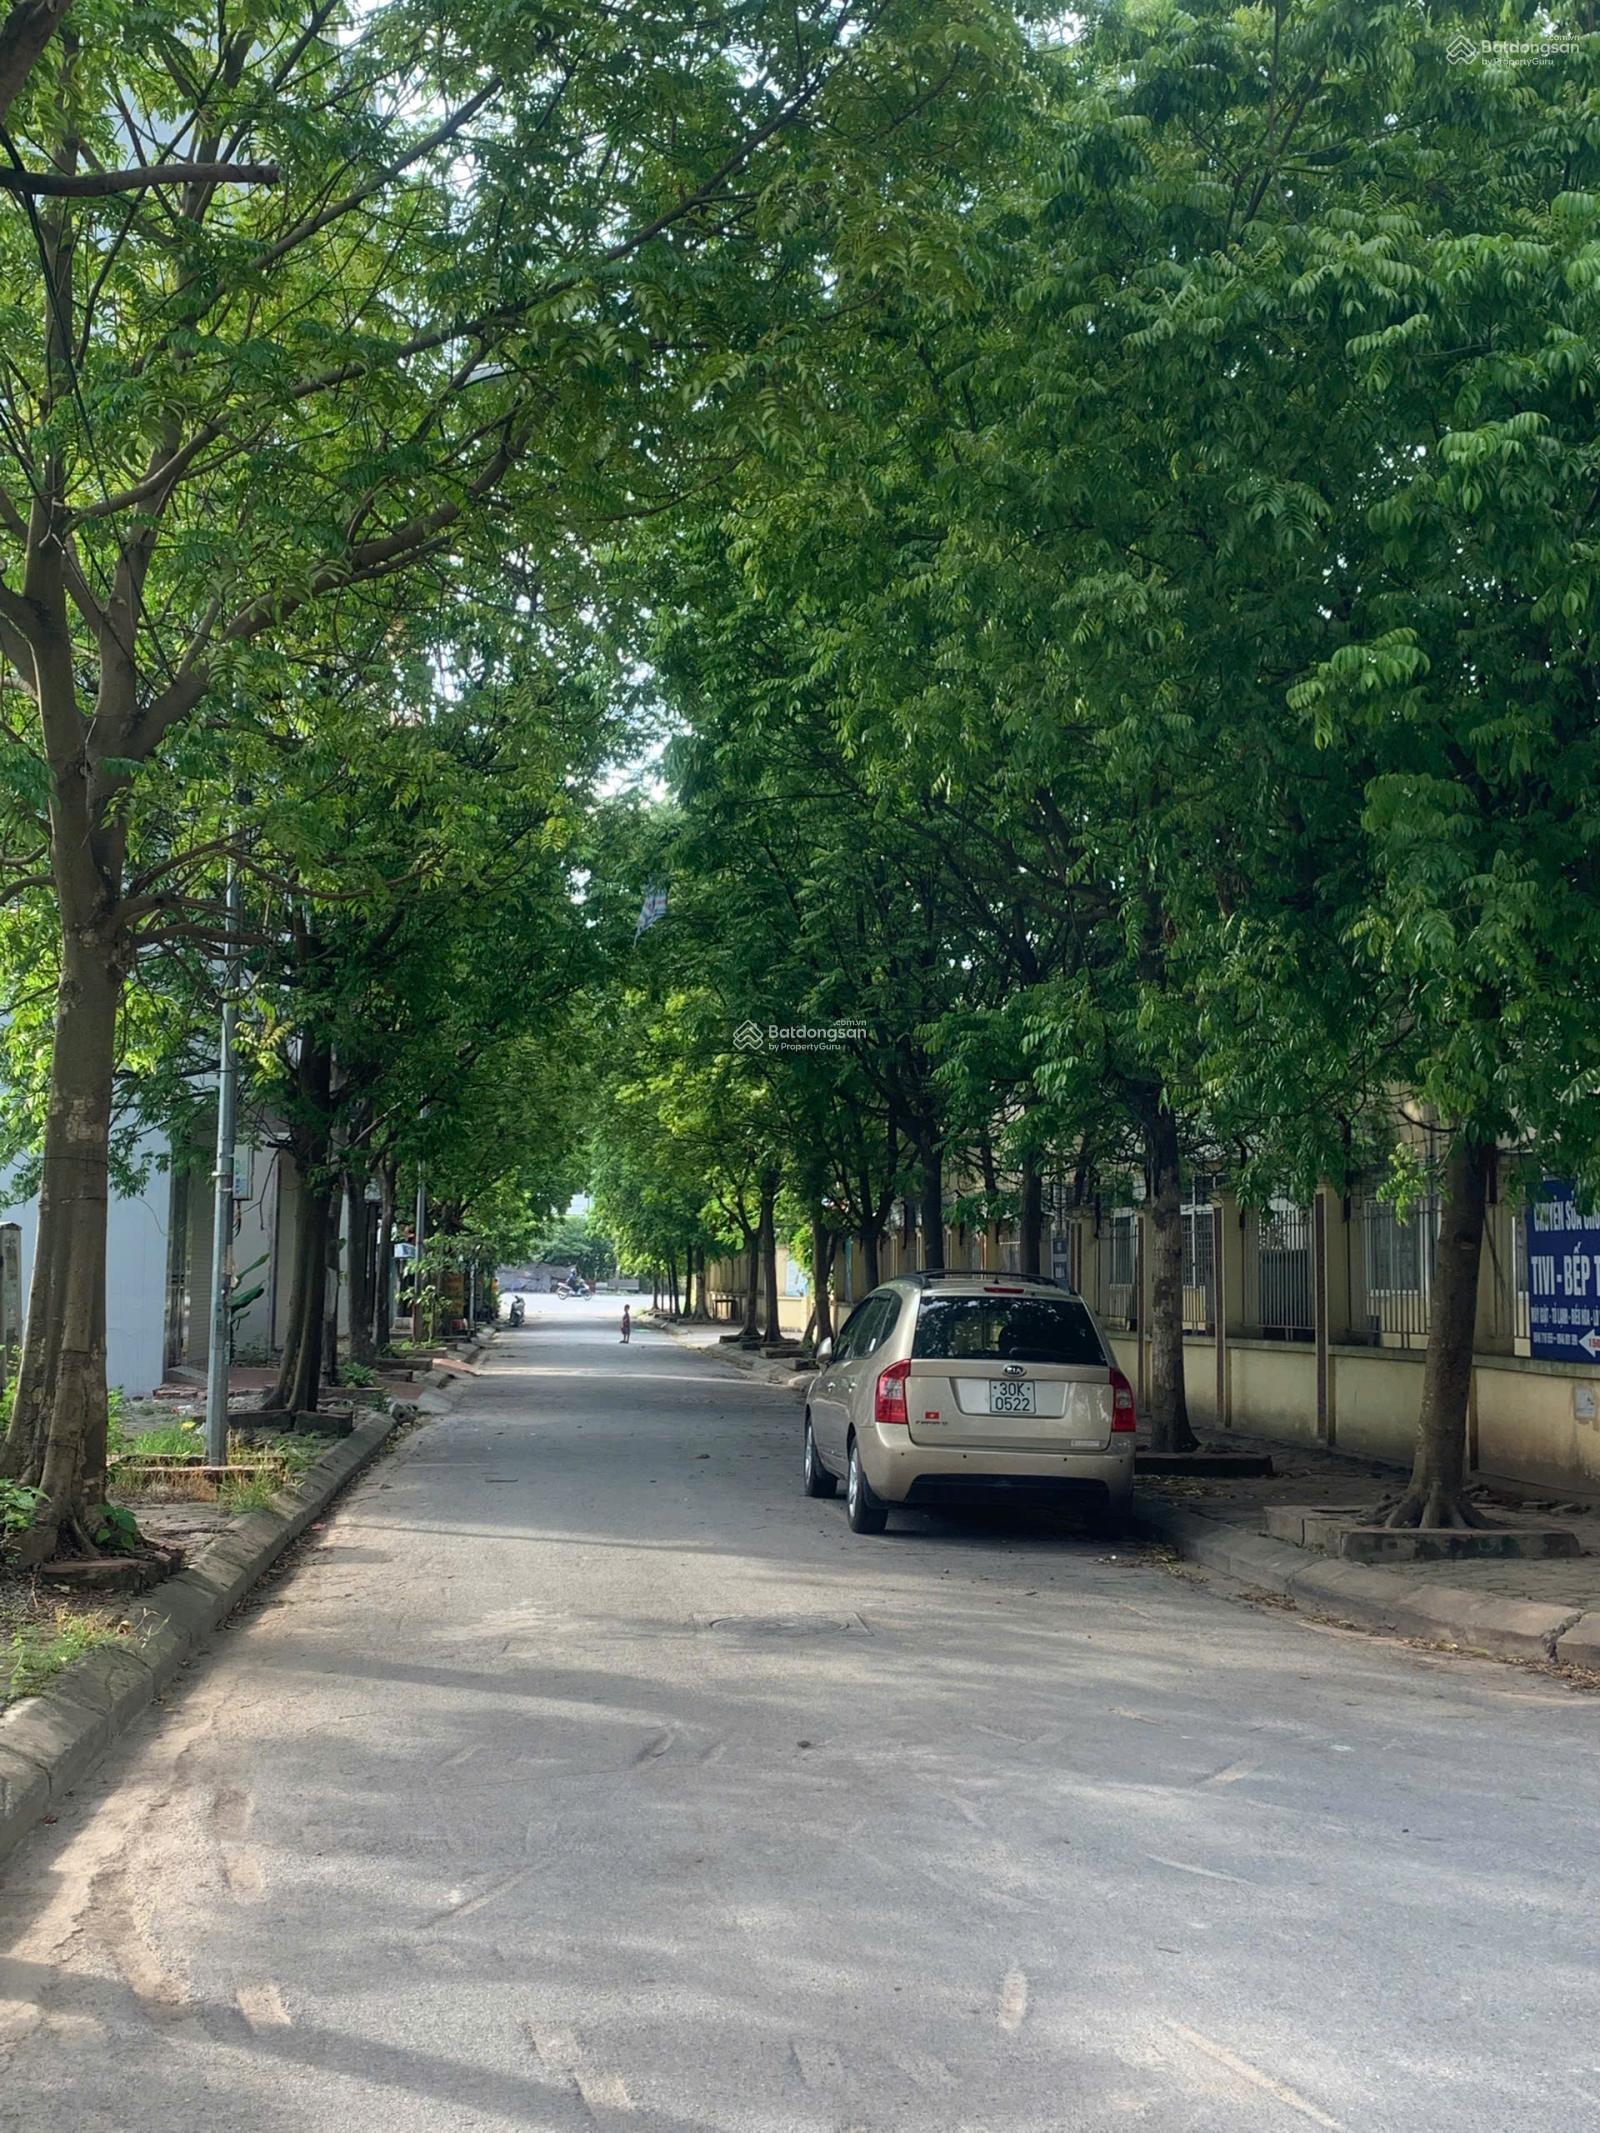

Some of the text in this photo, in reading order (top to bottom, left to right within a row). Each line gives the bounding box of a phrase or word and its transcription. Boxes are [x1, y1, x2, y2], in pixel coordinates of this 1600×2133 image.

[1530, 1255, 1555, 1296] TIVI
[1563, 1241, 1591, 1296] BẾP
[1005, 1366, 1024, 1374] KIA
[999, 1382, 1025, 1397] 30K
[995, 1397, 1030, 1412] 0522
